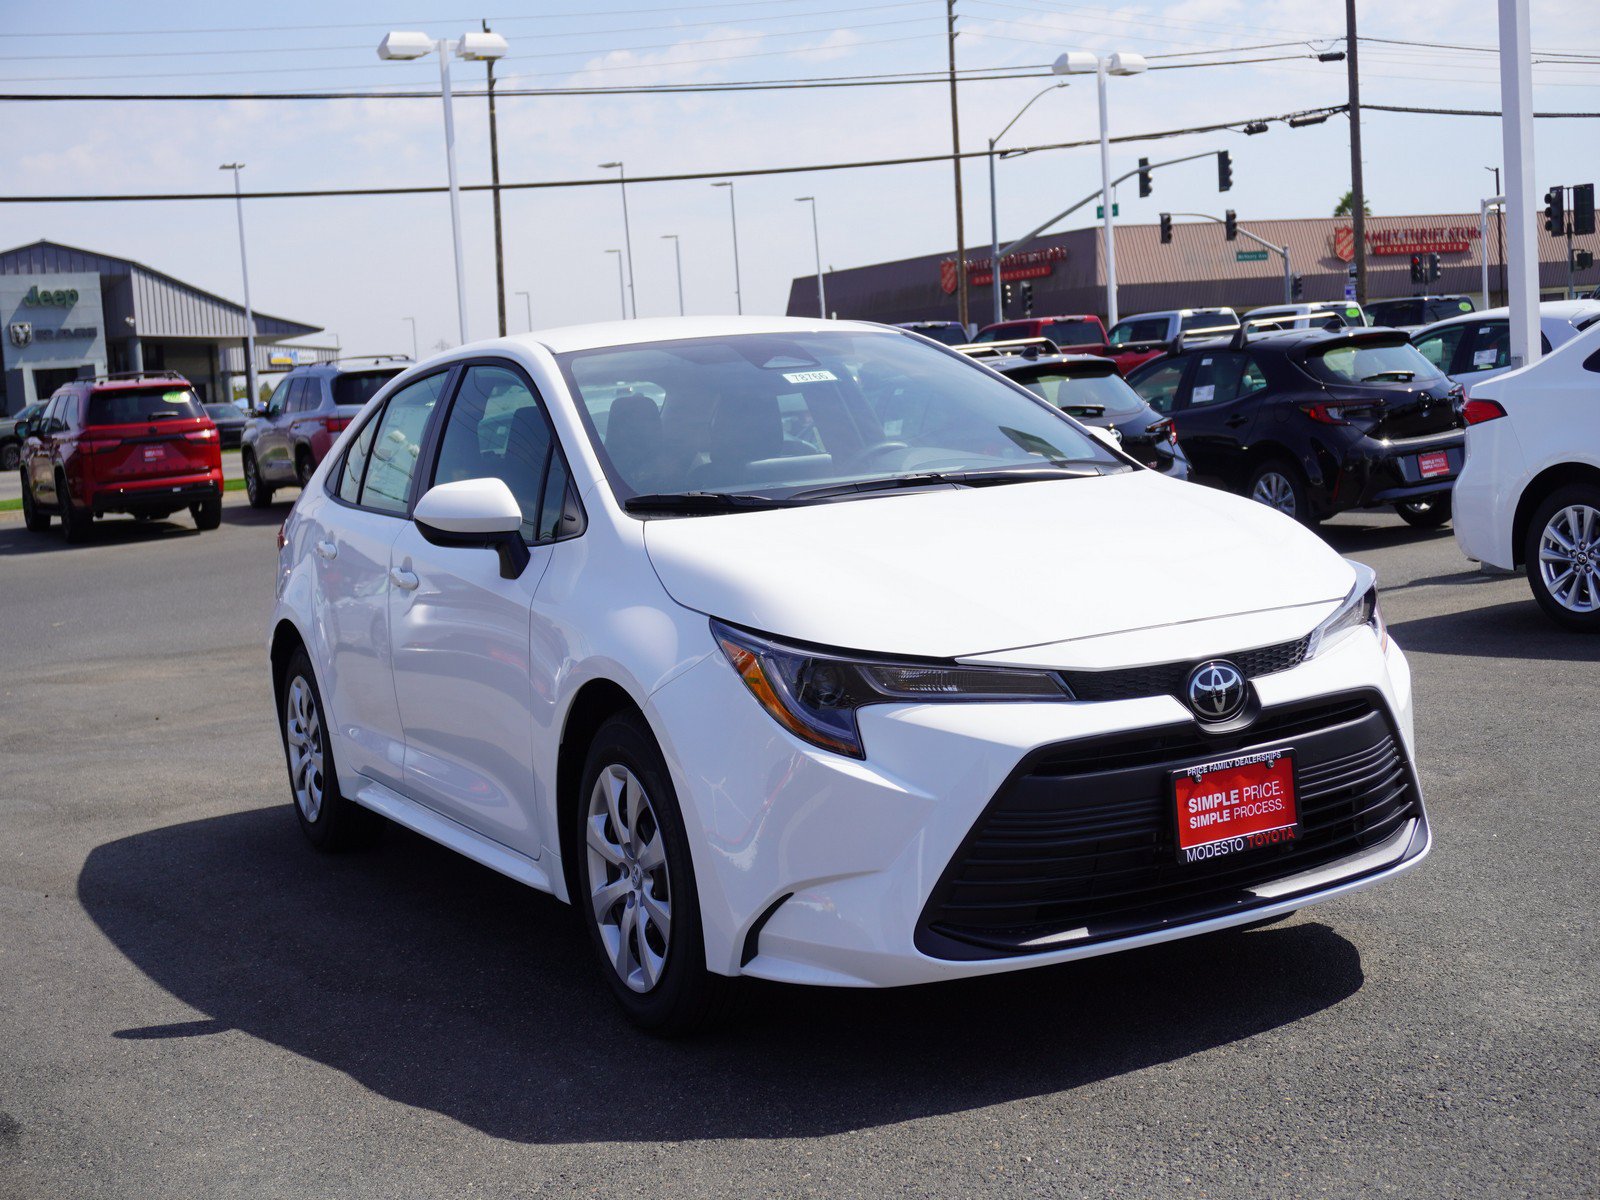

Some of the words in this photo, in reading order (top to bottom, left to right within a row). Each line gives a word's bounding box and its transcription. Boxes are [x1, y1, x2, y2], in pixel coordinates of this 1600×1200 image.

[1364, 229, 1400, 244] AMILY
[1403, 227, 1446, 242] THRIFT
[1380, 244, 1427, 253] DONATION
[1429, 243, 1464, 251] CENTER
[23, 285, 79, 308] Jeep
[791, 372, 829, 381] 78766
[1187, 766, 1208, 777] PRICE
[1209, 760, 1235, 772] FAMILY
[1235, 751, 1282, 767] DEALERSHIPS
[1188, 789, 1239, 814] SIMPLE
[1243, 780, 1284, 802] PRICE.
[1189, 809, 1231, 829] SIMPLE
[1233, 798, 1285, 820] PROCESS.
[1186, 837, 1244, 863] MODESTO
[1247, 827, 1295, 849] TOYOTA
